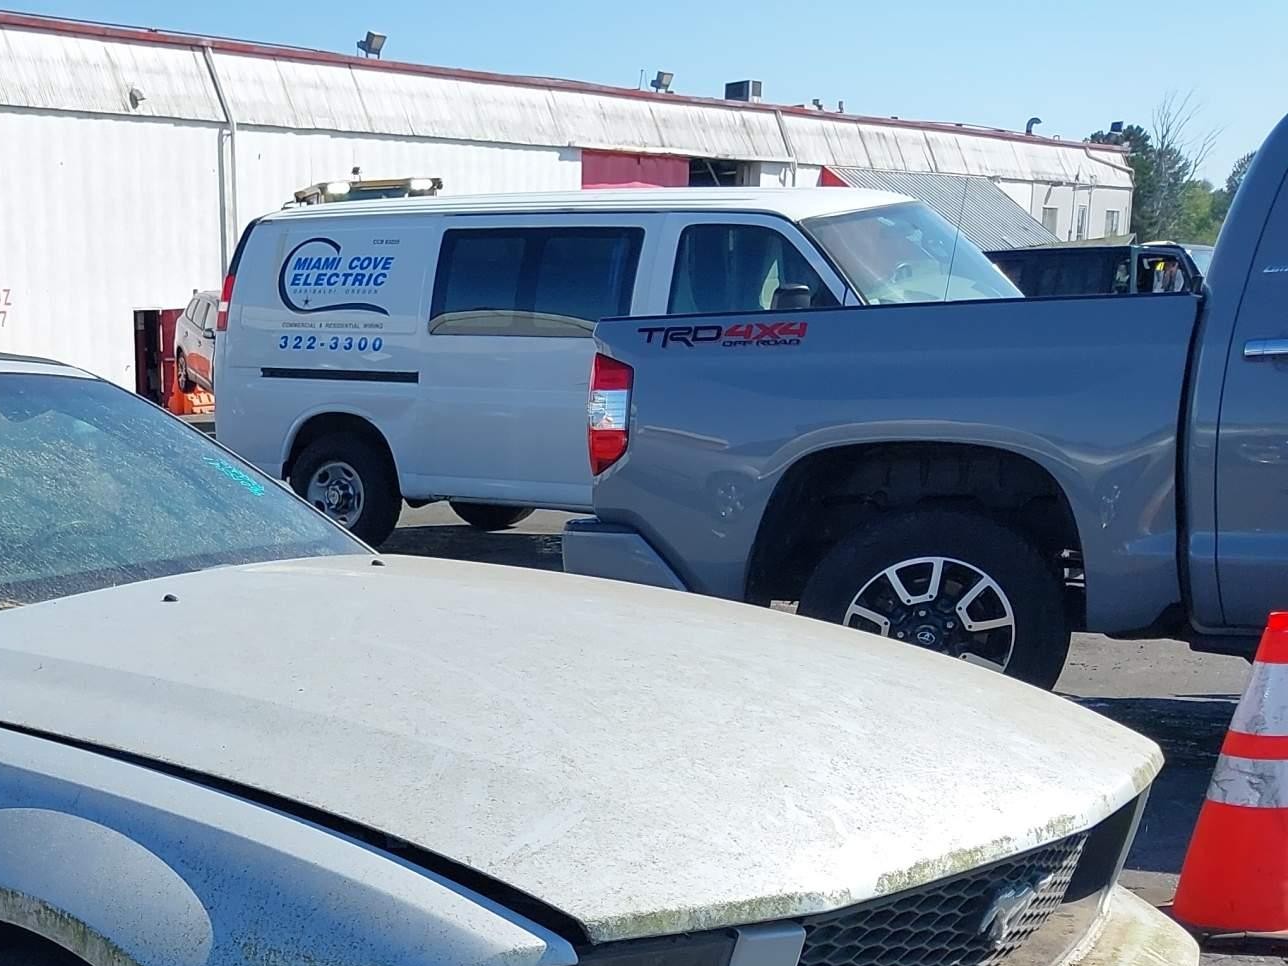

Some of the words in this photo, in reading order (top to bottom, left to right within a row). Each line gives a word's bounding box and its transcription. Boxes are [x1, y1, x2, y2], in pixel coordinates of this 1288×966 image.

[293, 256, 343, 271] MIAMI
[348, 256, 395, 271] COVE
[290, 272, 388, 287] ELECTRIC
[0, 311, 7, 327] 7
[279, 335, 383, 351] 322-3300
[638, 325, 723, 349] TRD
[722, 340, 753, 348] OFF
[756, 338, 801, 347] ROAD
